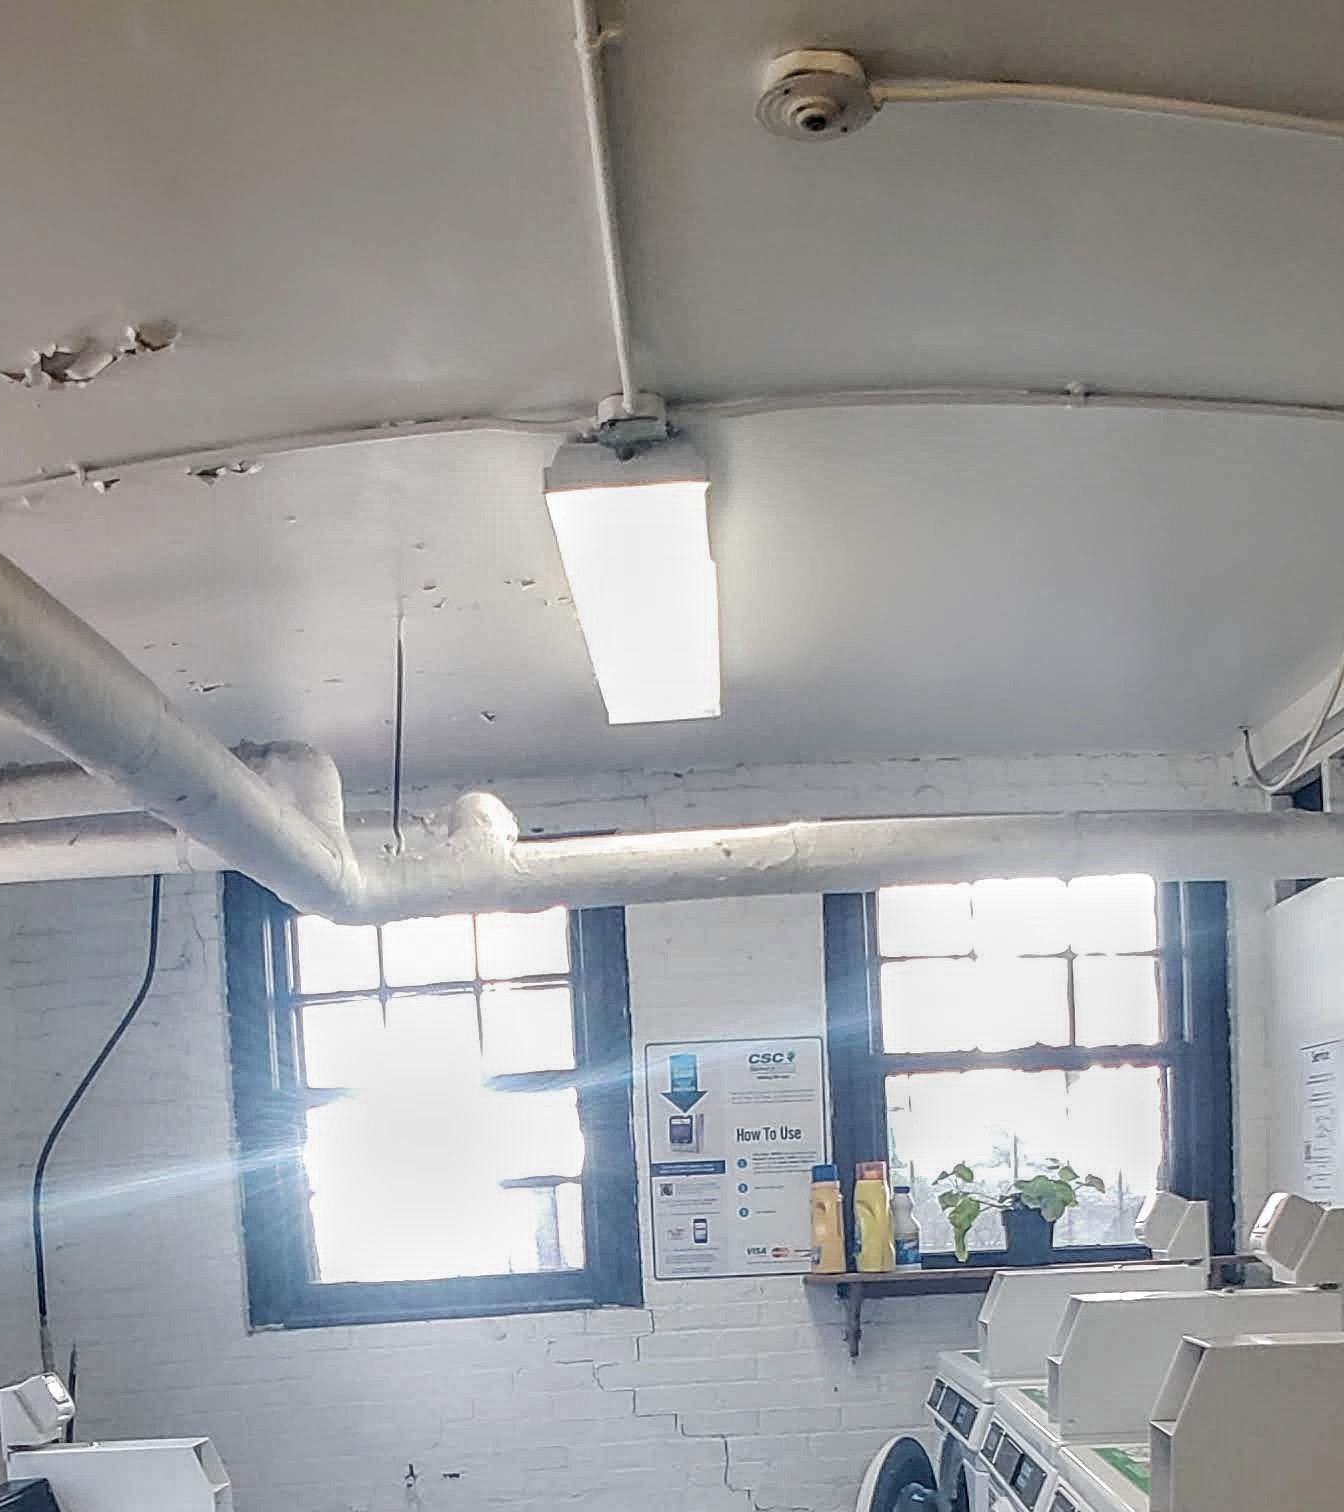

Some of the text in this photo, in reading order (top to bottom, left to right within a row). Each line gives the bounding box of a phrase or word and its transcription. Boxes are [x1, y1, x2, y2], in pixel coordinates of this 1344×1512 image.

[748, 1052, 784, 1064] CSC
[736, 1125, 802, 1142] How To Use
[746, 1247, 768, 1256] VISA
